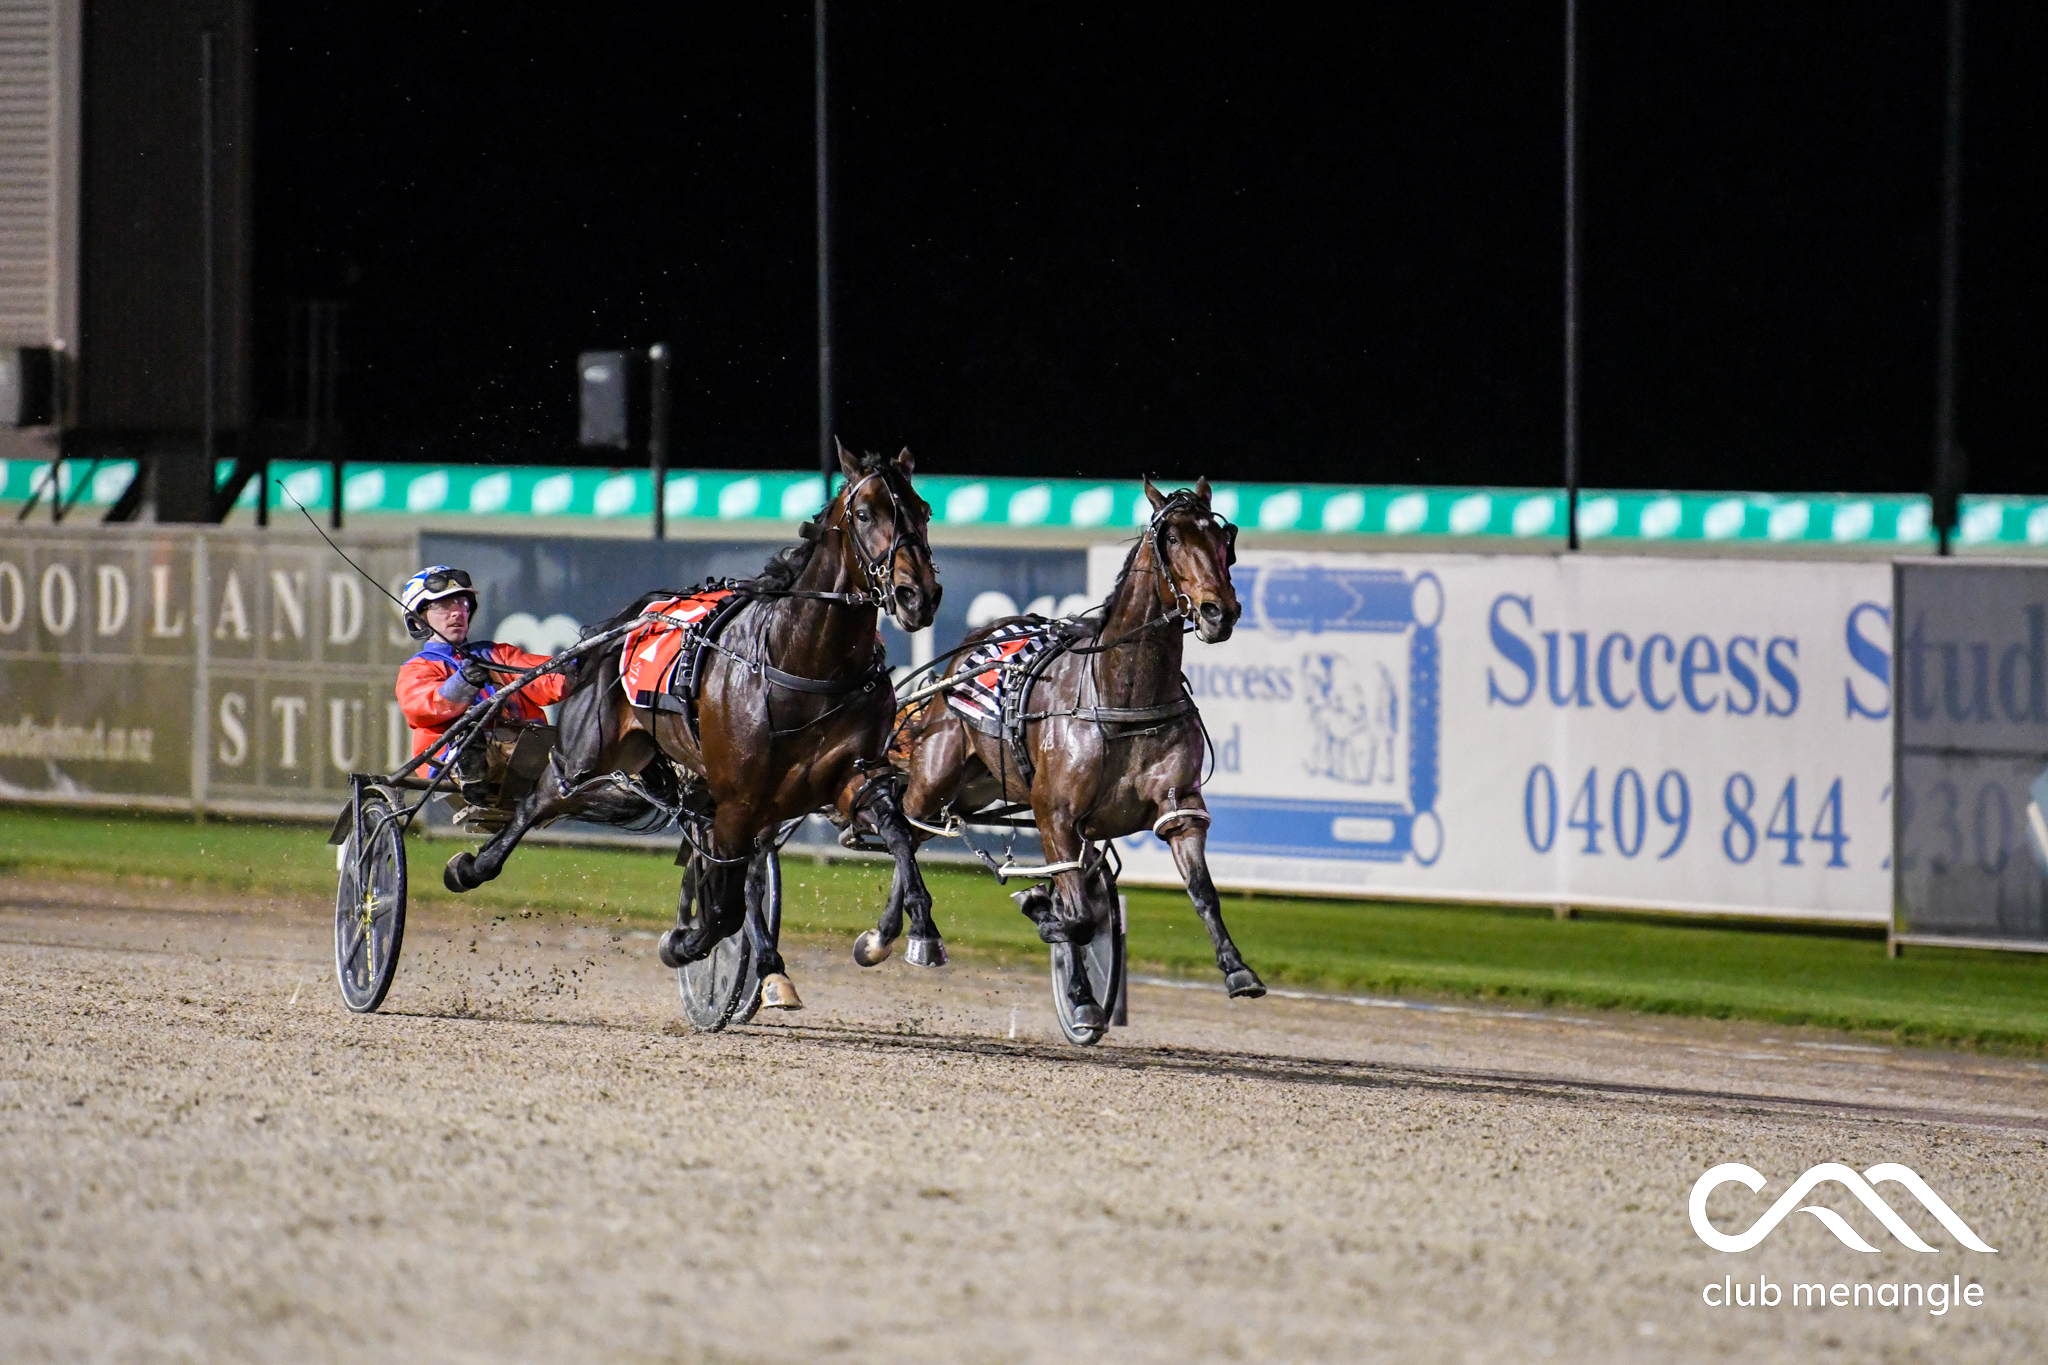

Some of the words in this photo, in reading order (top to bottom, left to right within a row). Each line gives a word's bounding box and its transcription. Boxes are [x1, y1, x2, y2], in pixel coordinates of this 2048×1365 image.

[1186, 663, 1294, 701] uccess
[1487, 592, 1801, 717] Success
[1523, 763, 1691, 860] 0409
[1722, 772, 1849, 869] 844
